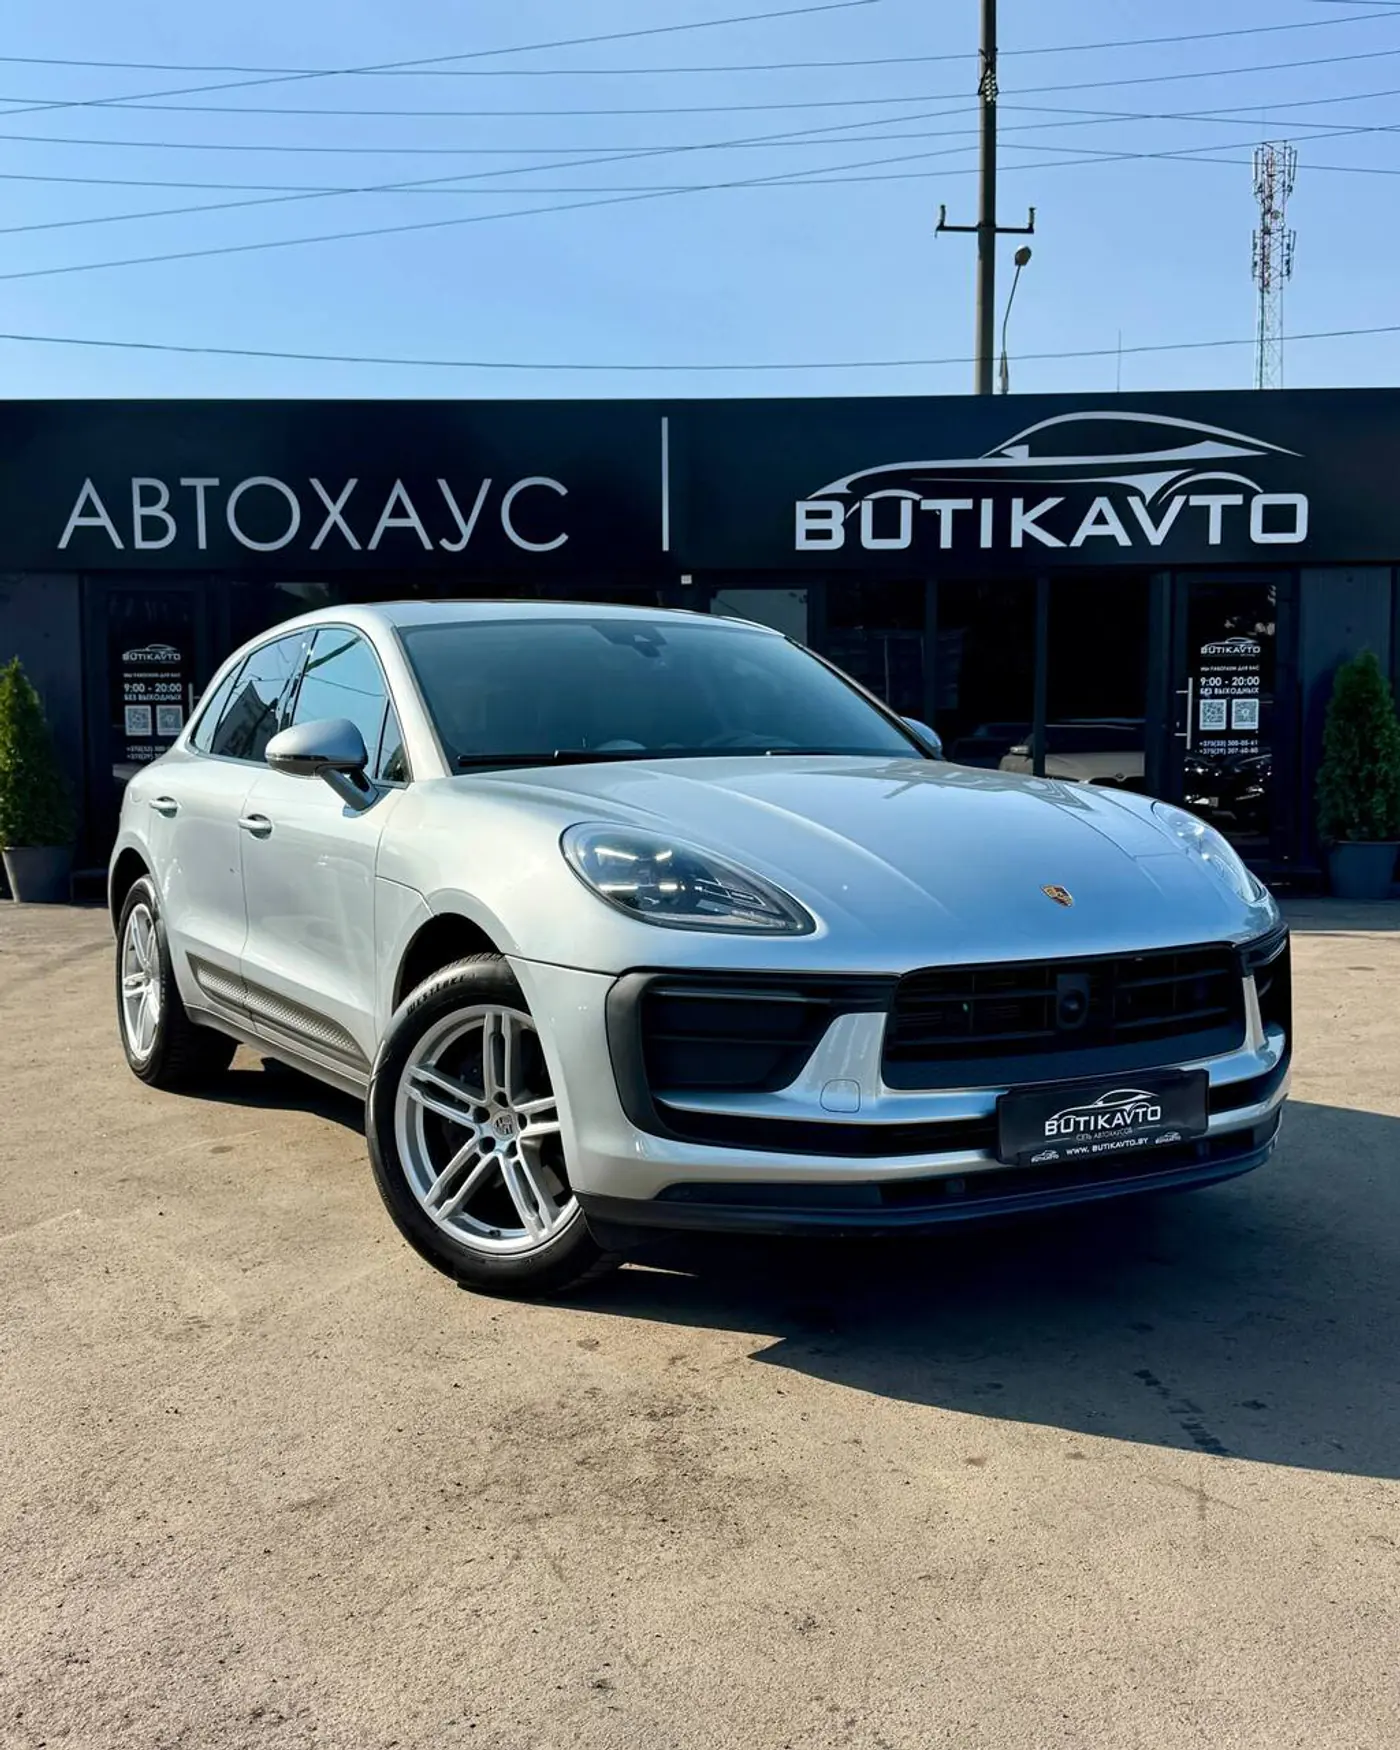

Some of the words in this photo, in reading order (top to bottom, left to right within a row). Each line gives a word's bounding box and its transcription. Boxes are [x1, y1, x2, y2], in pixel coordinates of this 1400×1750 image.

[57, 475, 570, 553] АВТОХАУС
[795, 492, 1308, 551] BUTIKAVTO
[1200, 646, 1260, 654] BUTIKAVTO
[124, 683, 145, 692] 9:00
[155, 683, 182, 692] 20:00
[1200, 676, 1222, 686] 9:00
[1231, 676, 1260, 686] 20:00
[1044, 1105, 1161, 1136] BUTIKAVTO
